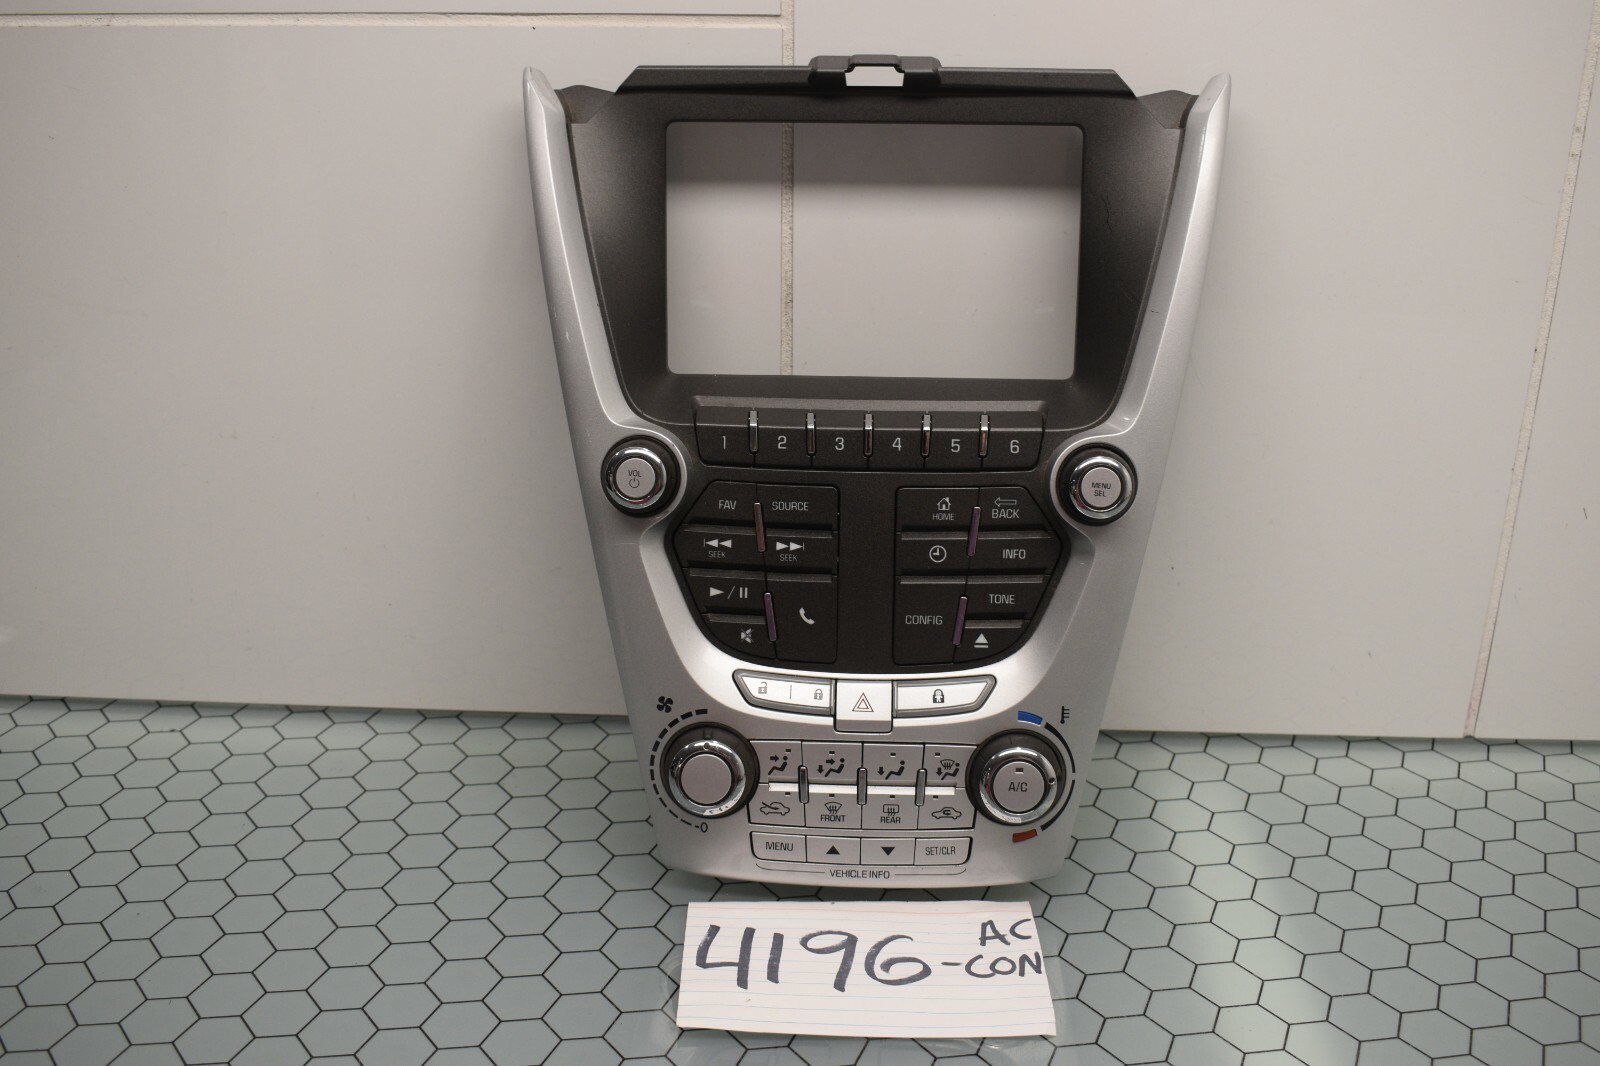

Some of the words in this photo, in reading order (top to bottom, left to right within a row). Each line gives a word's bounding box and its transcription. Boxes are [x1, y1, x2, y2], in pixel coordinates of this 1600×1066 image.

[722, 435, 727, 450] 1
[777, 435, 788, 450] 2
[835, 437, 845, 451] 3
[892, 437, 902, 452] 4
[950, 438, 961, 453] 5
[1009, 439, 1020, 454] 6
[628, 469, 642, 478] VOL
[1091, 481, 1112, 490] MENU
[1094, 490, 1107, 498] SEL
[718, 500, 737, 510] FAV
[771, 501, 809, 511] SOURCE
[932, 513, 955, 521] HOME
[991, 508, 1020, 519] BACK
[708, 551, 726, 559] SEEK
[779, 554, 798, 562] SEEK
[1002, 549, 1026, 560] INFO
[989, 594, 1016, 605] TONE
[905, 614, 943, 626] CONFIG
[1008, 781, 1028, 793] A/C
[820, 814, 846, 823] FRONT
[880, 816, 901, 824] REAR
[765, 841, 794, 851] MENU
[925, 846, 956, 856] SET/CLR
[829, 869, 867, 879] VEHICLE
[869, 870, 890, 879] INFO
[979, 918, 1032, 946] AC
